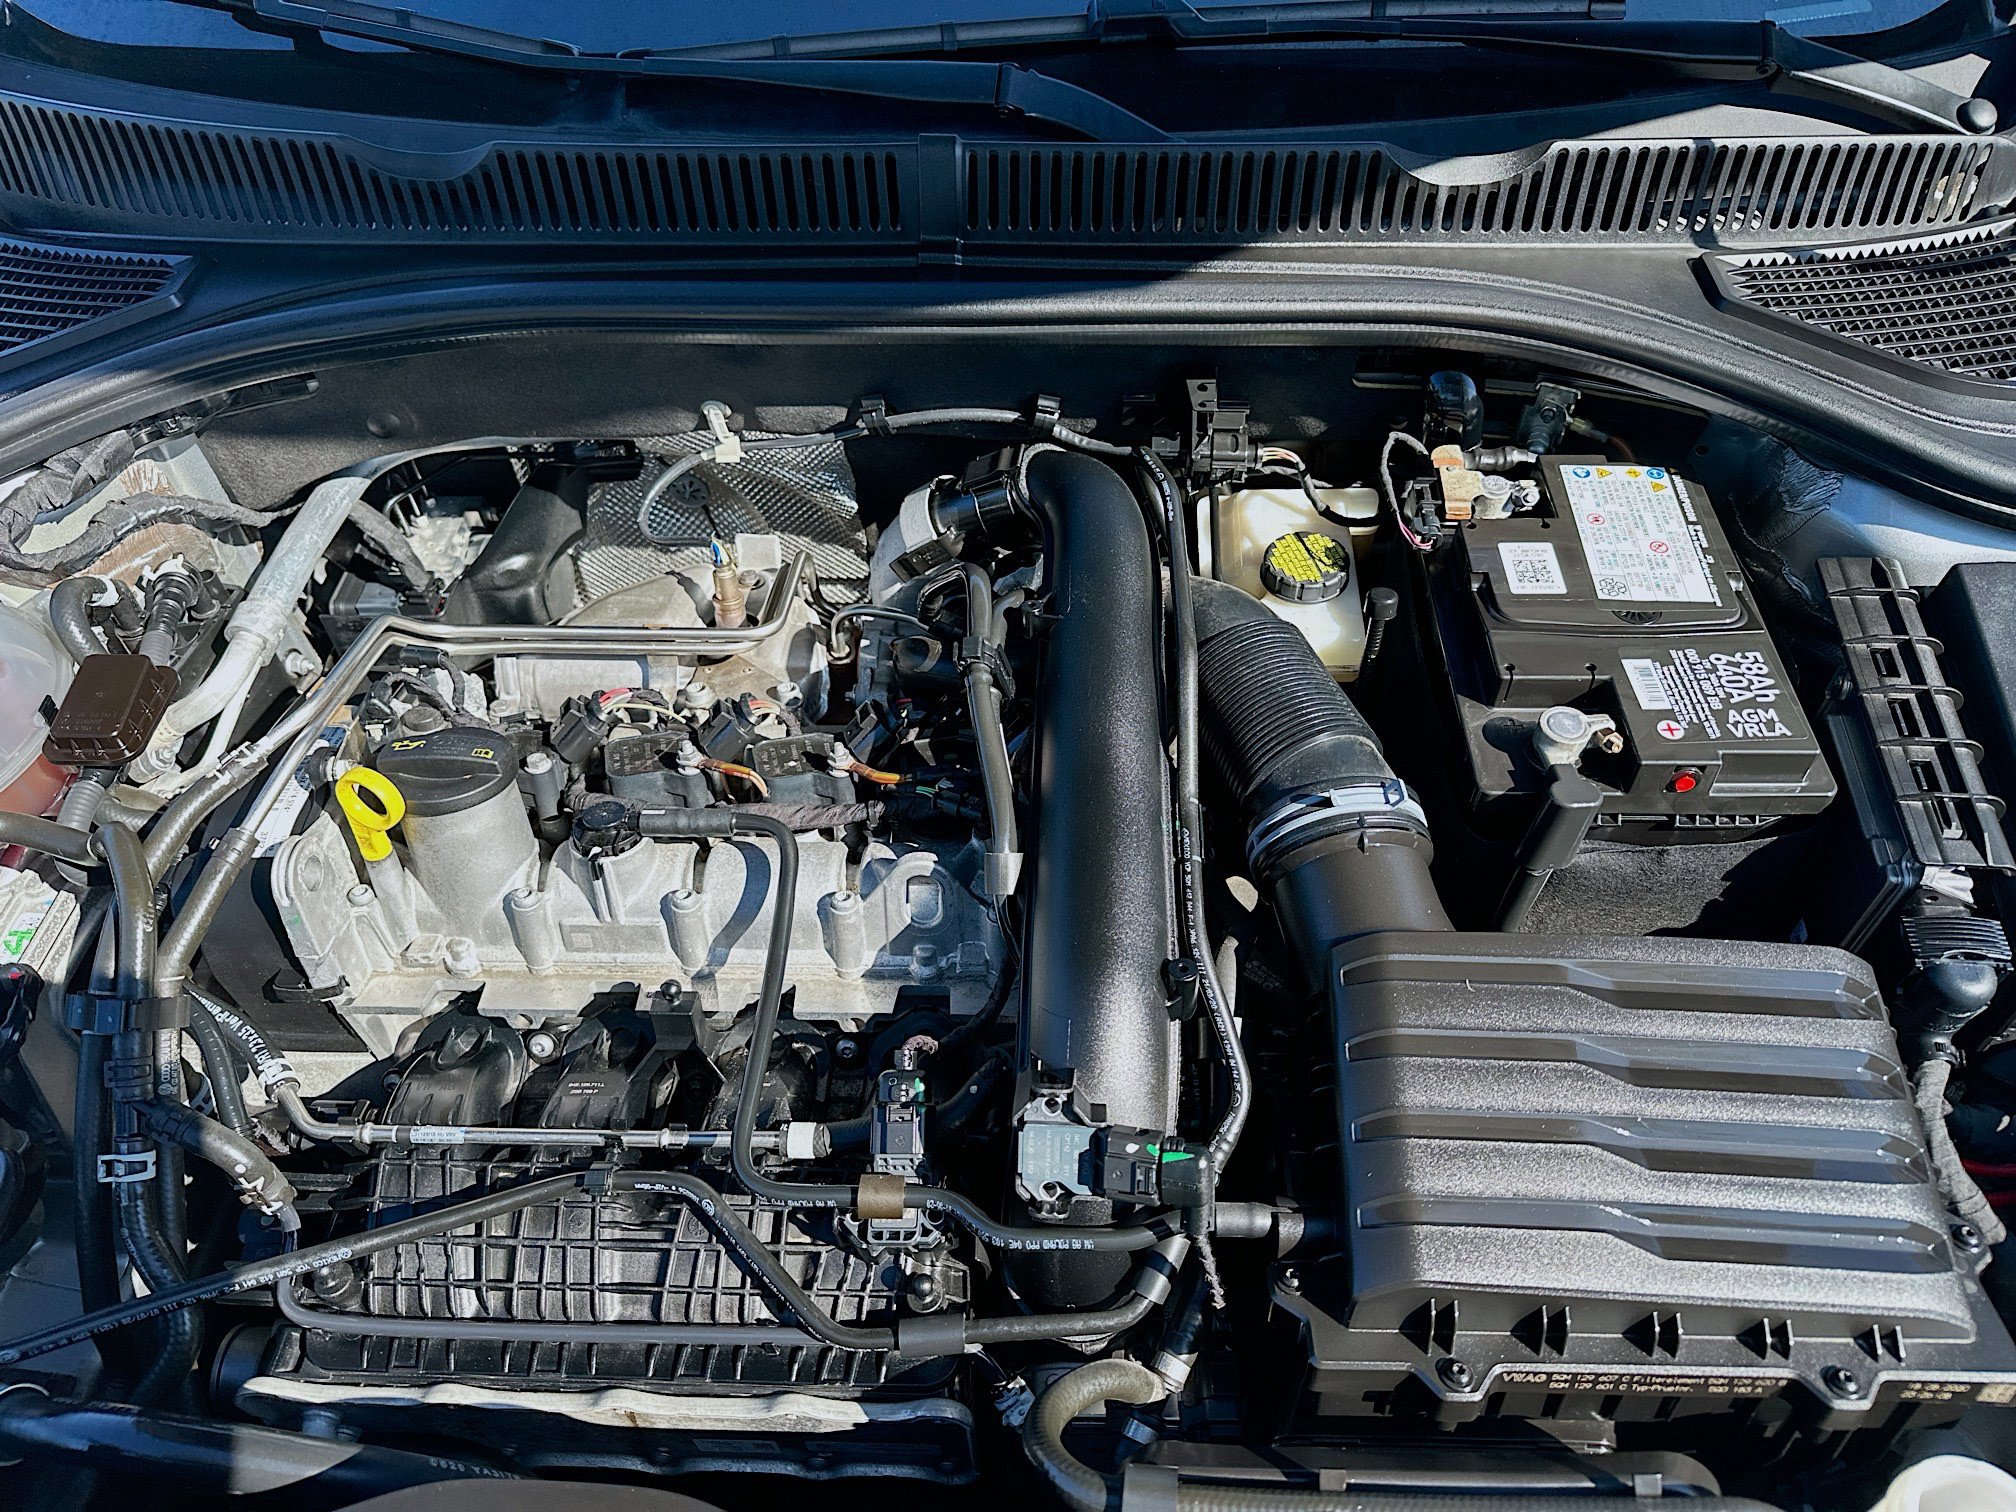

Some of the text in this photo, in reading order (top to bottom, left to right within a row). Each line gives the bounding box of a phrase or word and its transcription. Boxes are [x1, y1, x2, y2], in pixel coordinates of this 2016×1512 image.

[1692, 664, 1706, 681] 915
[1709, 653, 1755, 704] 640A
[1735, 651, 1781, 703] 58Ah
[1728, 708, 1780, 724] AGM
[1726, 722, 1793, 738] VRLA
[1041, 1238, 1069, 1249] POLAND
[1501, 1371, 1547, 1384] VWAG
